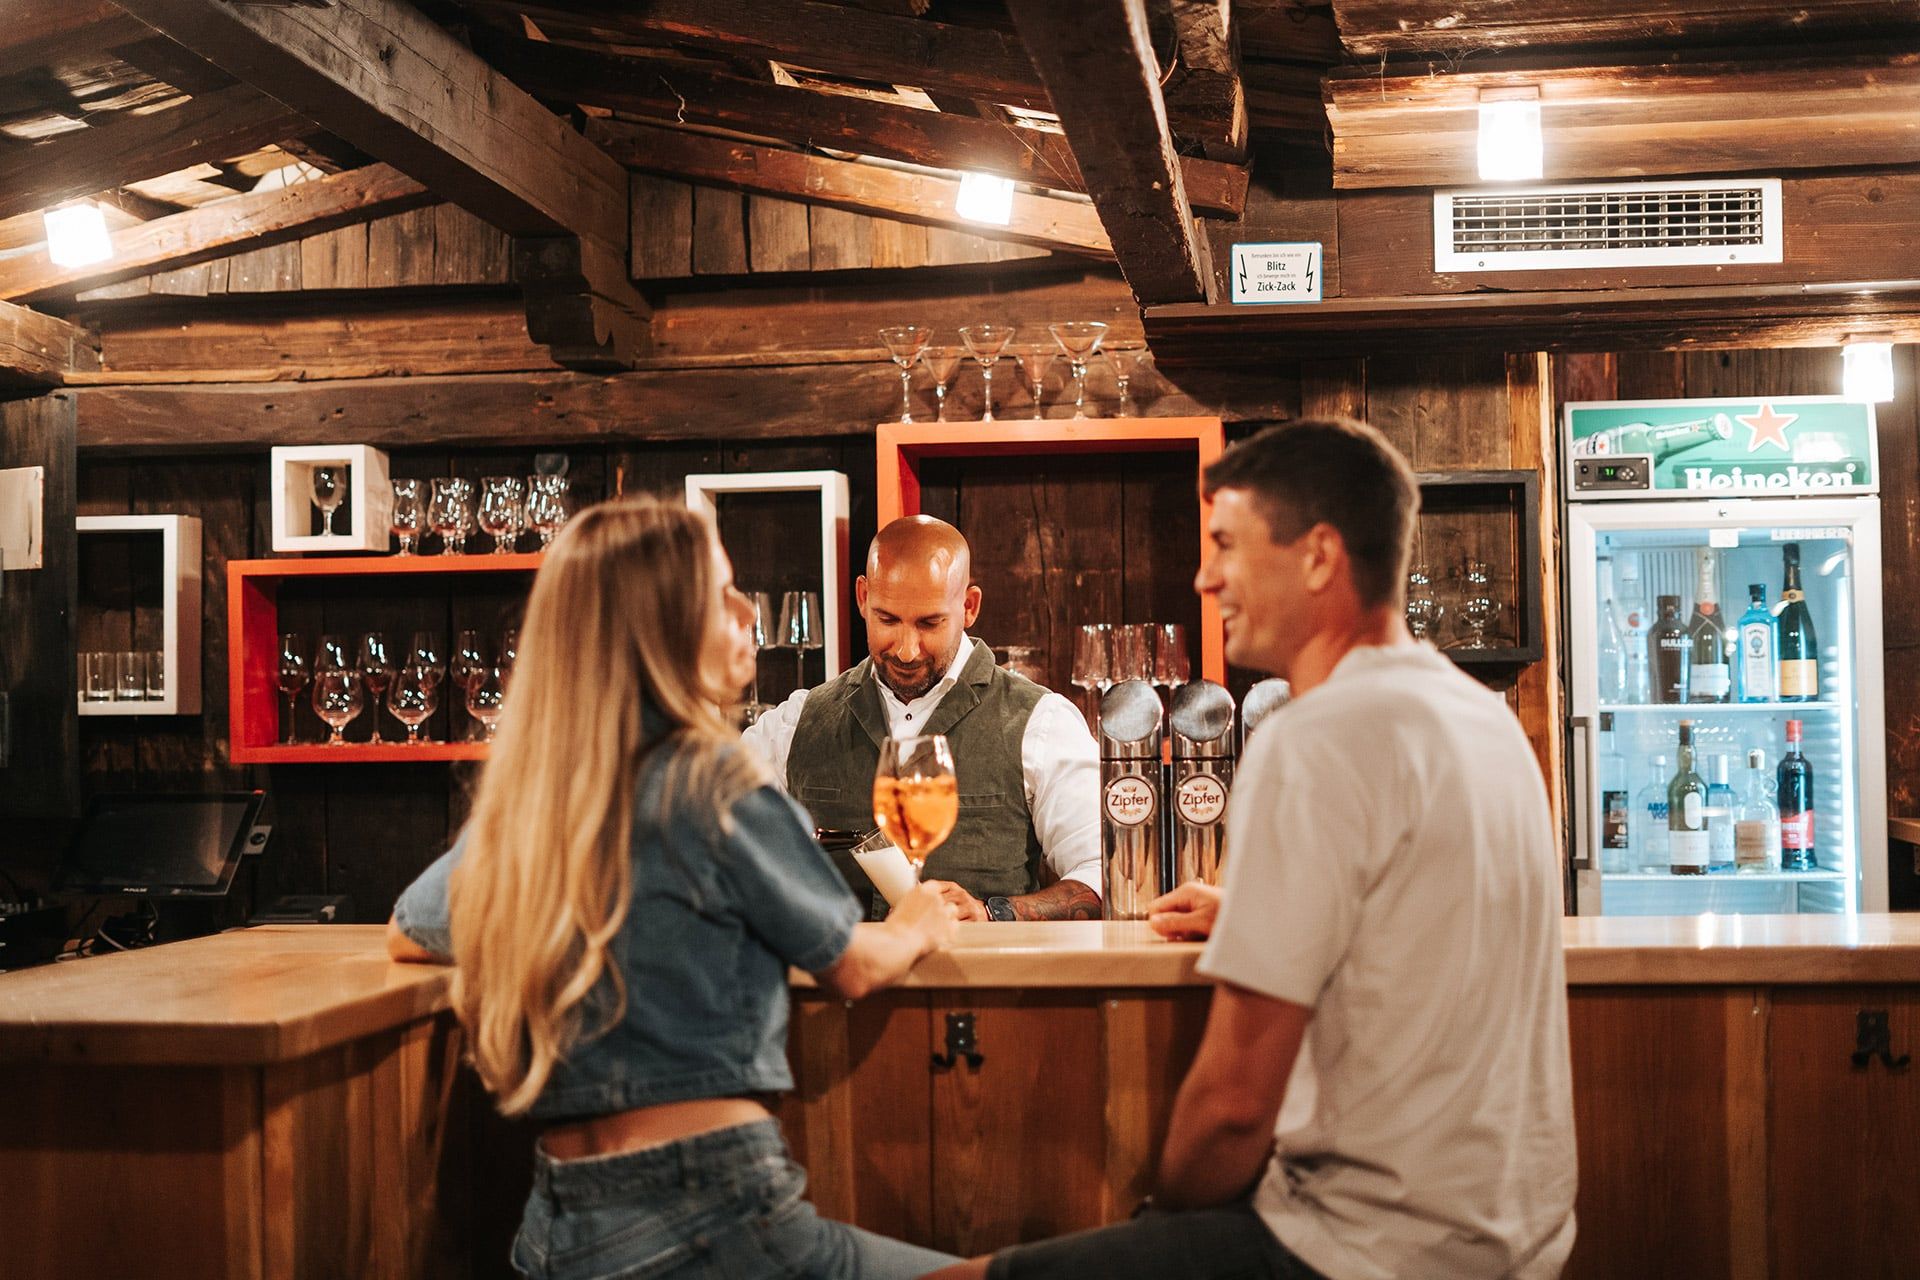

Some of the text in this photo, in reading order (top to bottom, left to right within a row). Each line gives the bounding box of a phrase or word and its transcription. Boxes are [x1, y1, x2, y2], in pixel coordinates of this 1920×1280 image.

[1267, 261, 1286, 271] Blitz
[1257, 281, 1296, 292] Zick-Zack
[1684, 466, 1853, 490] Heineken
[1111, 794, 1149, 809] Zipfer
[1182, 793, 1220, 808] Zipfer
